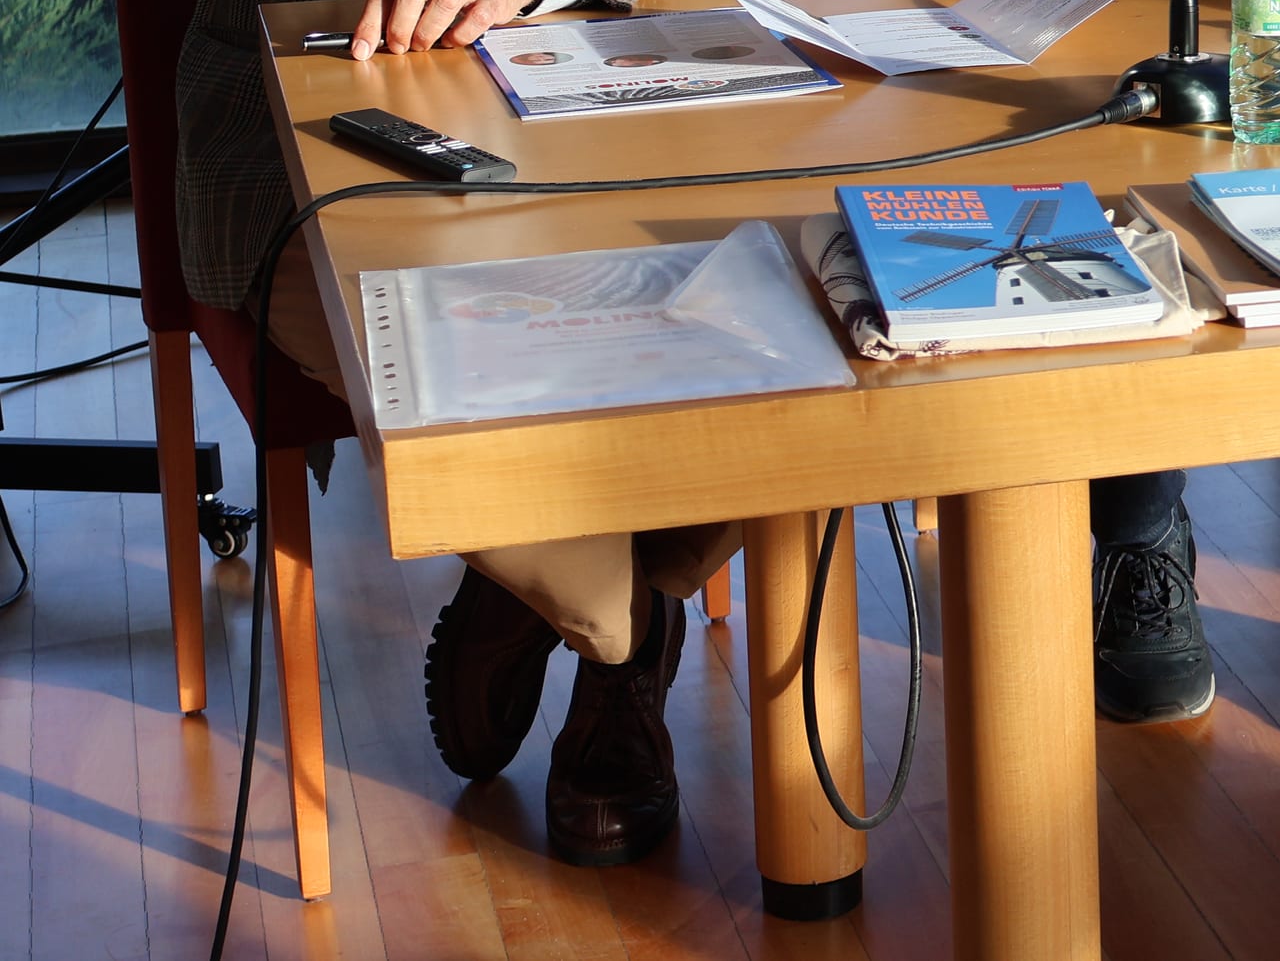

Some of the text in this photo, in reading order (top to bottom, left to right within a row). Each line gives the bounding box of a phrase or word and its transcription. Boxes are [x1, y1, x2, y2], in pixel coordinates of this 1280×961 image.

[1218, 184, 1267, 195] Karte
[862, 190, 982, 201] KLEINE
[866, 200, 985, 210] MÜHLEN
[870, 210, 990, 221] KUNDE
